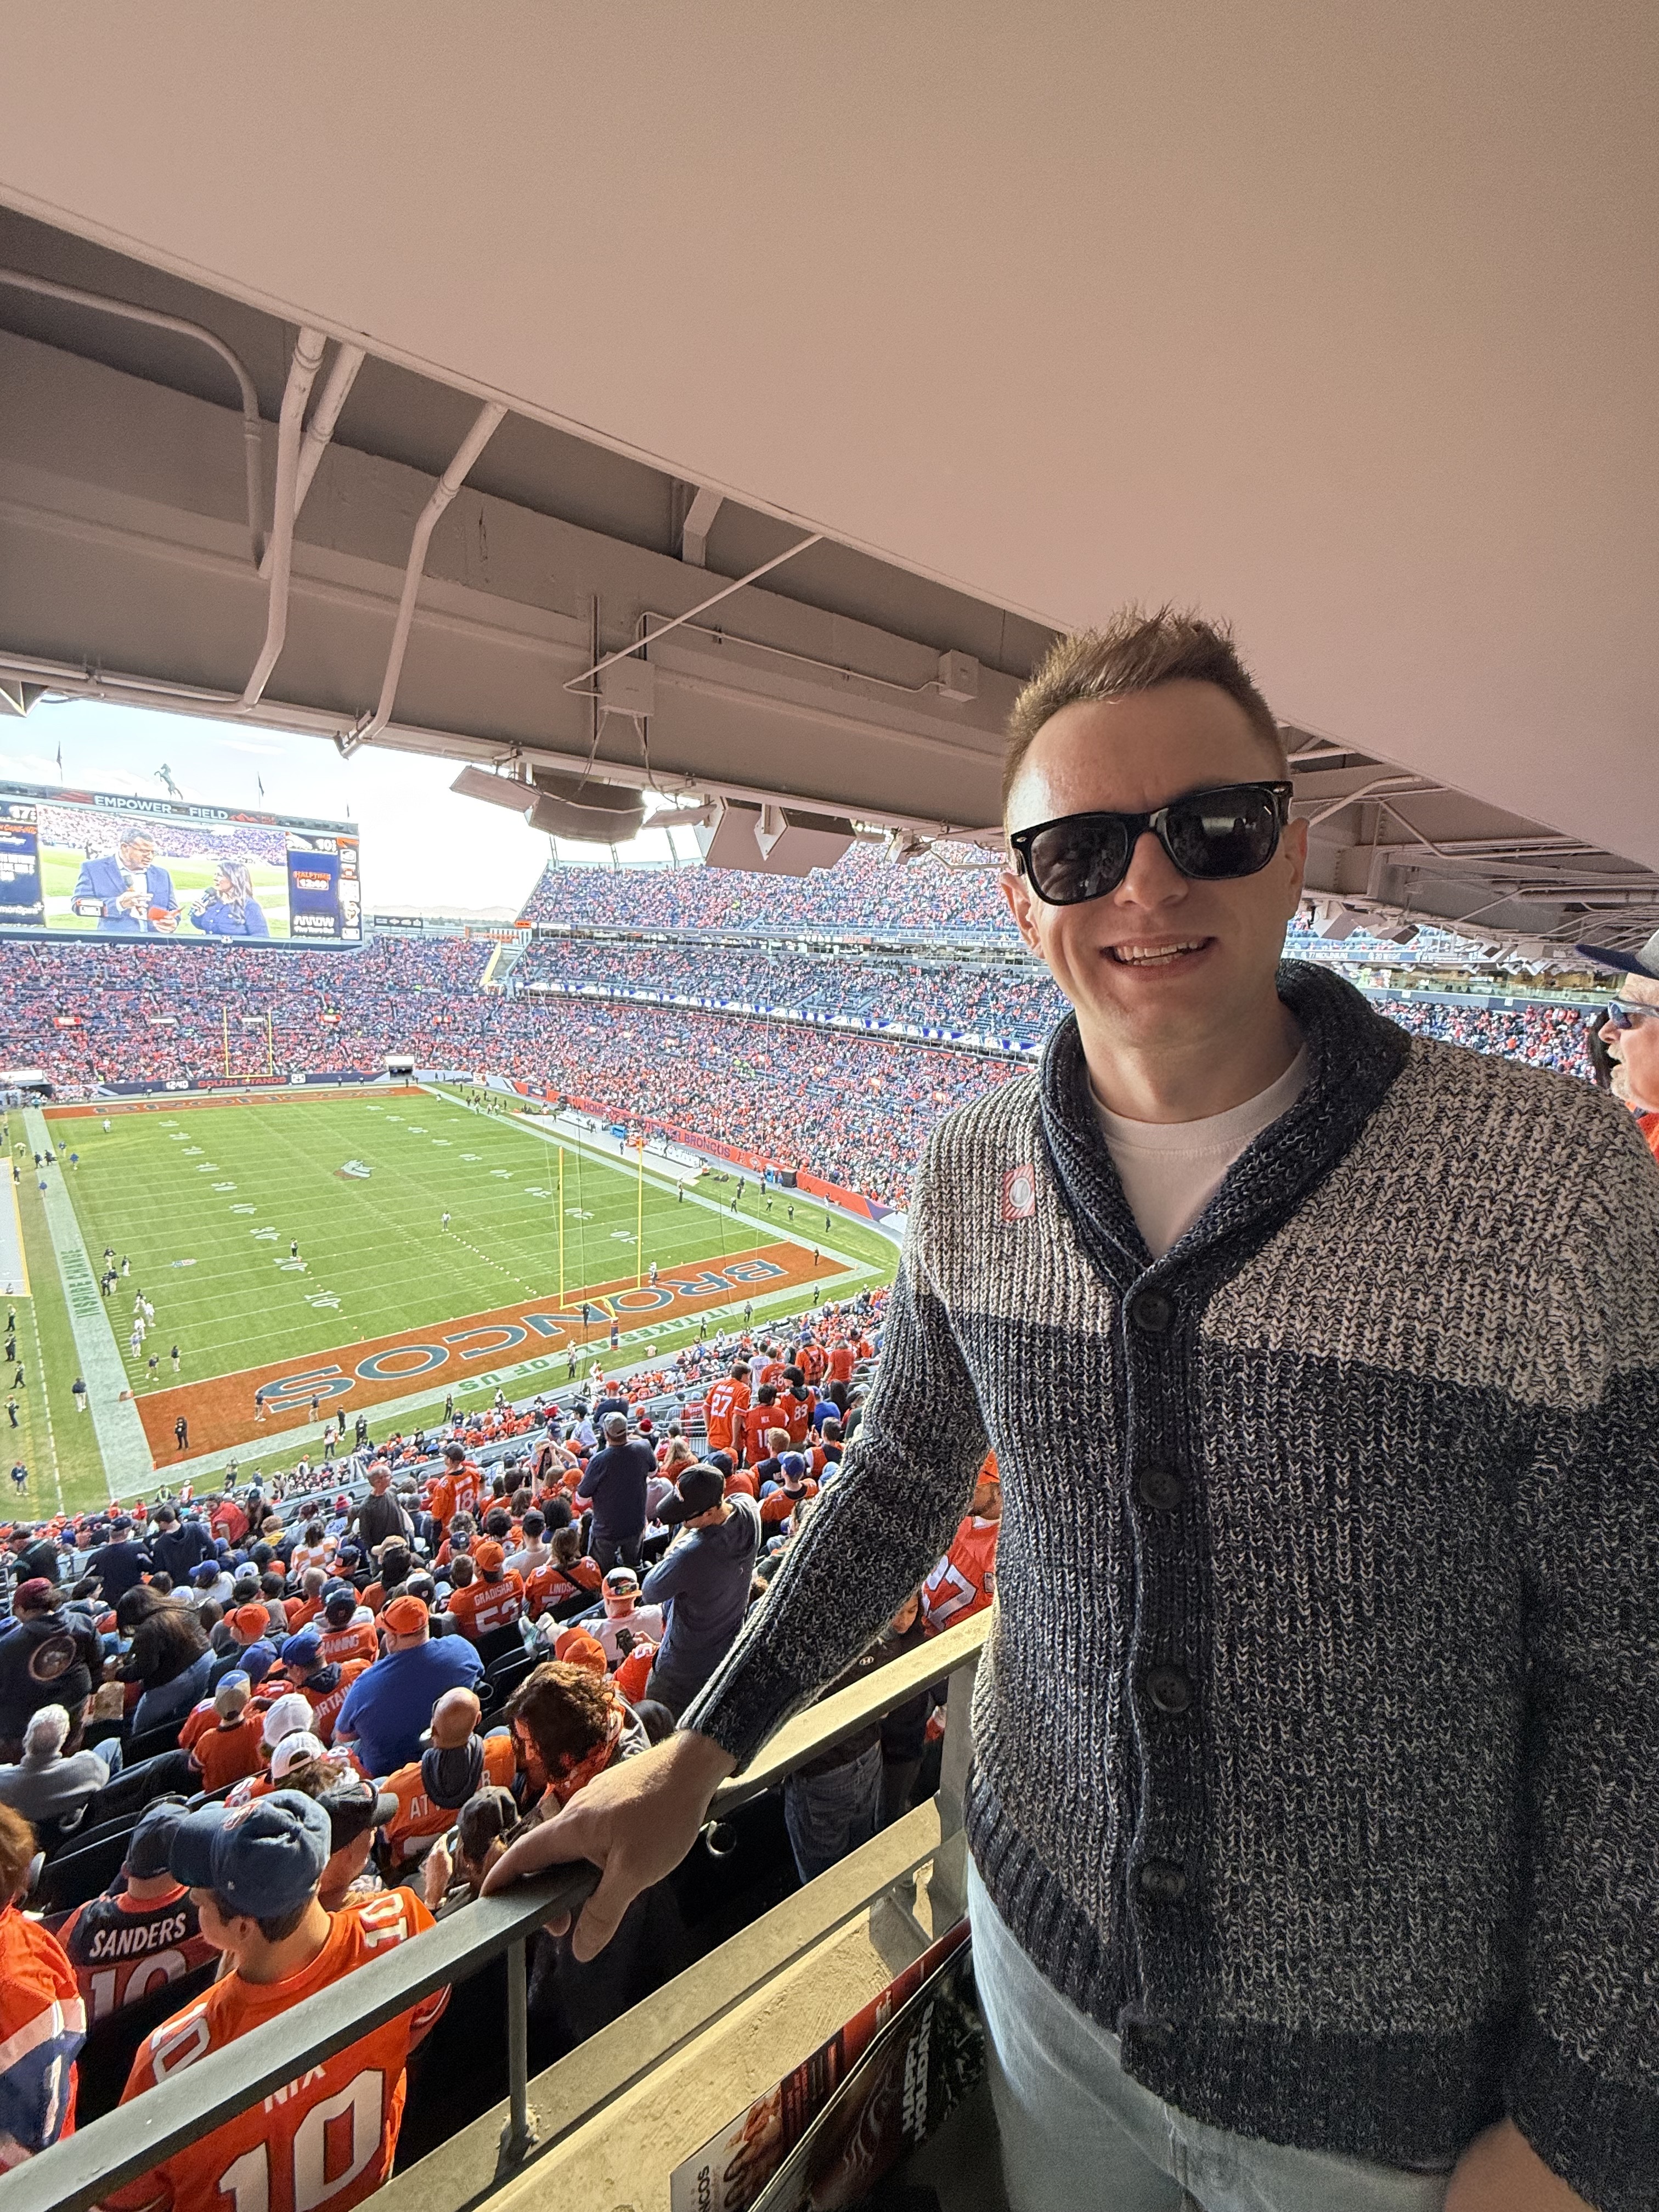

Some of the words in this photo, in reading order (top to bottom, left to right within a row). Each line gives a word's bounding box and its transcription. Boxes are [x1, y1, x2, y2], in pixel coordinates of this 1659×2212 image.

[94, 795, 171, 814] EMPOWER
[189, 807, 228, 820] FIELD
[198, 1079, 238, 1088] SOUTH
[242, 1076, 286, 1086] STANDS
[685, 1133, 731, 1158] BRONCOS
[61, 1249, 89, 1280] CHANGE
[69, 1281, 101, 1318] INSPIRE
[304, 1290, 342, 1308] 10
[255, 1259, 789, 1414] BRONCOS
[620, 1316, 700, 1342] TAKES
[514, 1359, 550, 1375] OF
[458, 1373, 502, 1391] US
[710, 1393, 733, 1418] 27
[455, 1488, 475, 1512] 18
[474, 1581, 515, 1606] GRADISHAR
[550, 1582, 575, 1595] LINDS
[360, 1893, 408, 1948] 10
[89, 1912, 187, 1958] SANDERS
[219, 2069, 384, 2212] 10
